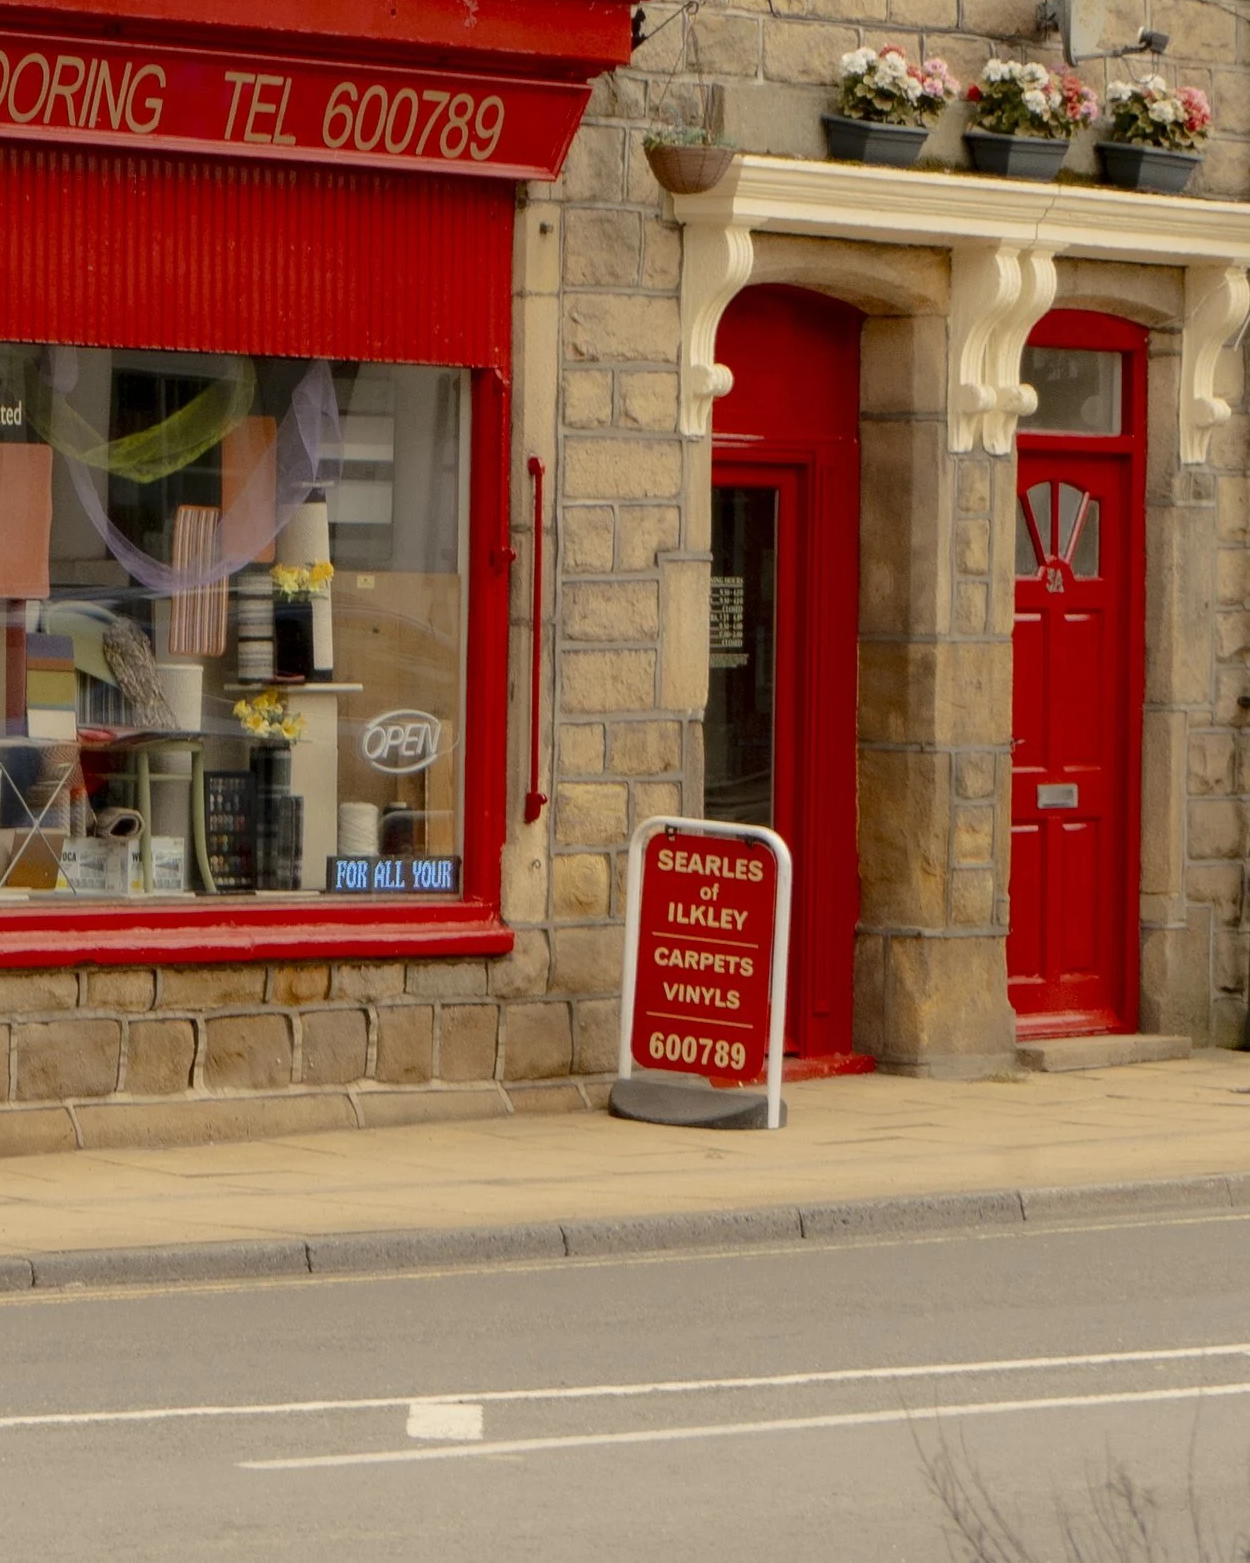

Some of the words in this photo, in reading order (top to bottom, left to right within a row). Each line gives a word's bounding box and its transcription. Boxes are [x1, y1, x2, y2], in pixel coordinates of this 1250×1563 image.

[224, 71, 296, 146] TEL
[322, 81, 505, 161] 600789
[363, 721, 441, 760] OPEN
[335, 860, 368, 888] FOR
[374, 860, 405, 888] ALL
[413, 860, 453, 888] YOUR
[657, 848, 763, 882] SEARLES
[700, 882, 719, 901] of
[668, 902, 748, 931] ILKLEY
[654, 947, 754, 977] CARPETS
[663, 981, 740, 1010] VINYLS
[649, 1031, 746, 1070] 600789
